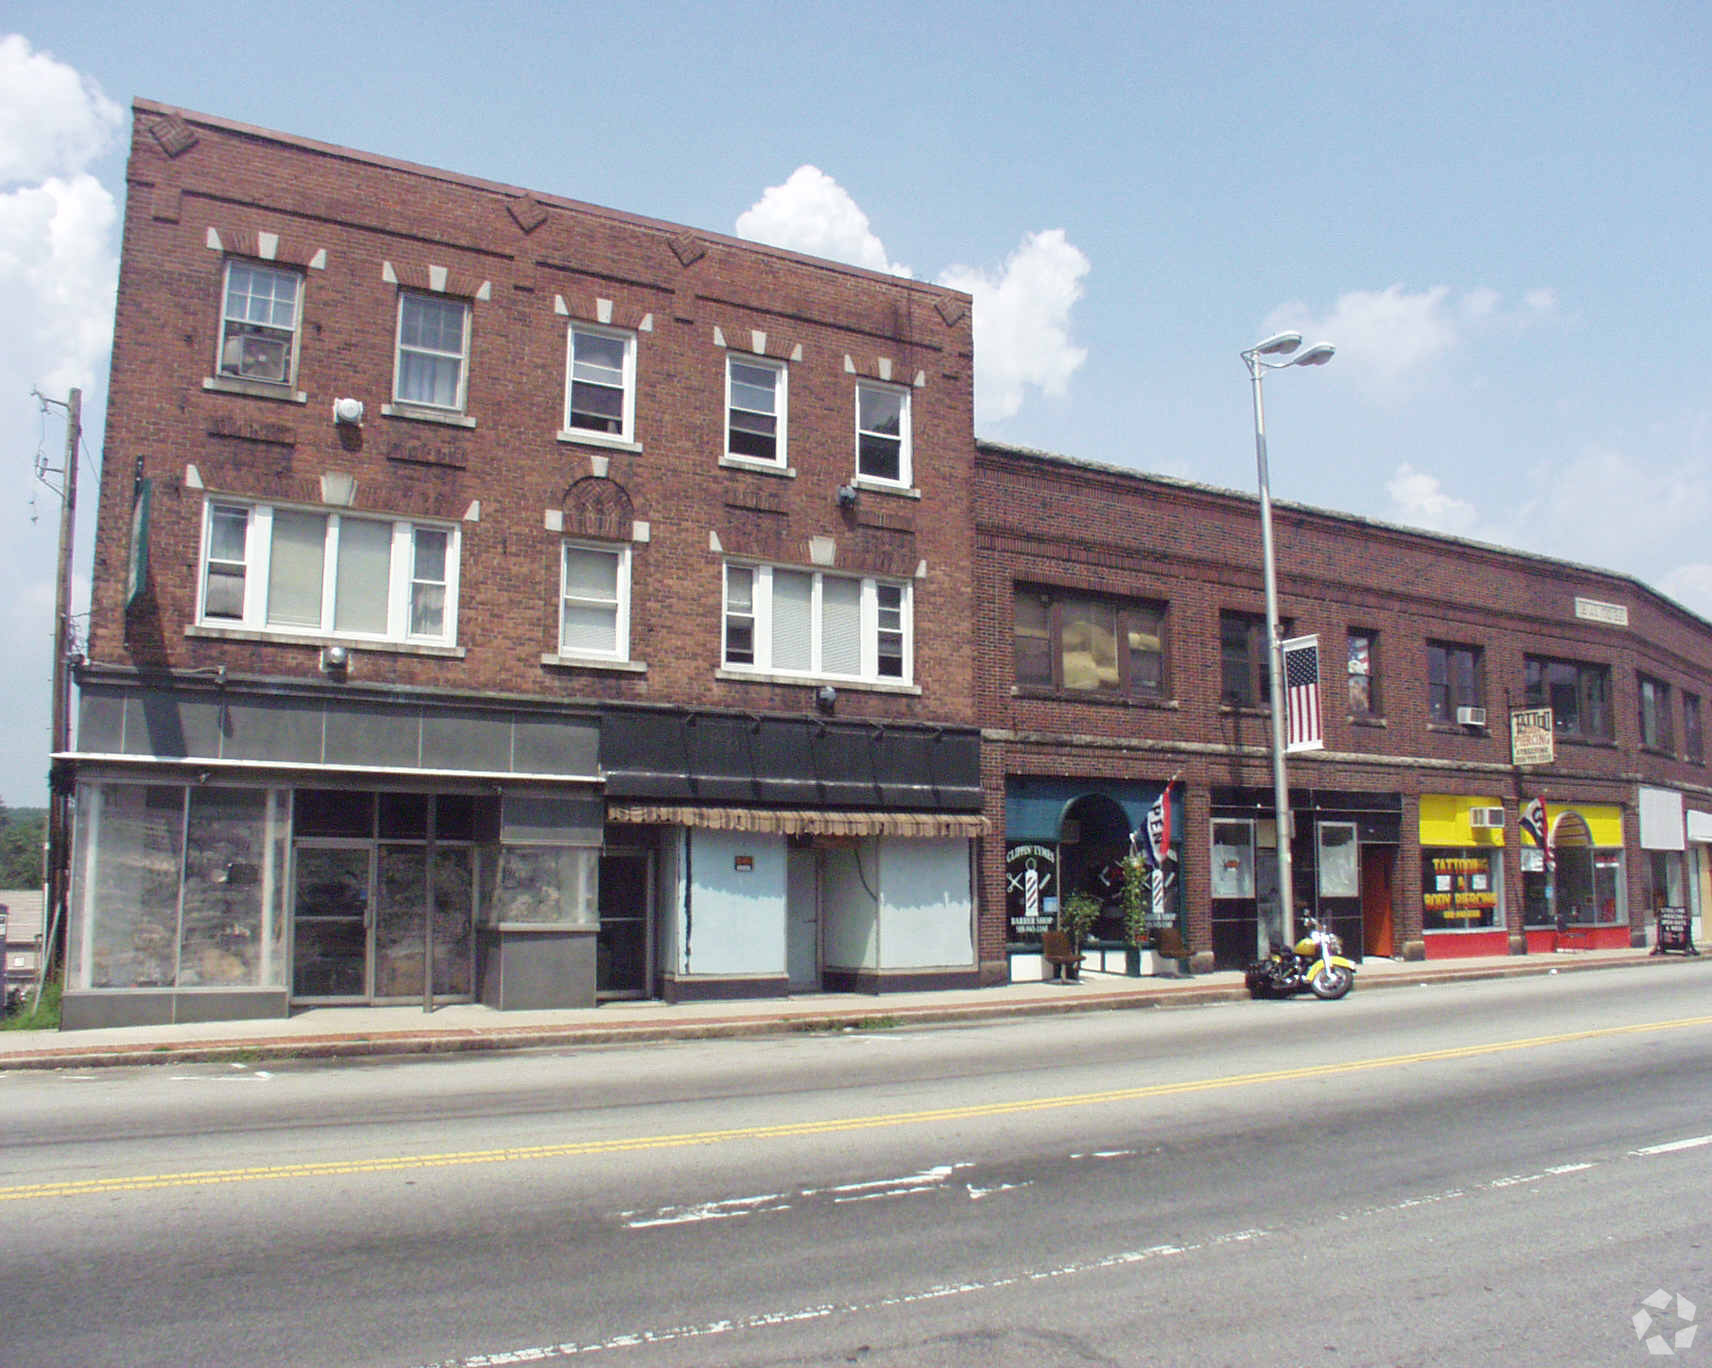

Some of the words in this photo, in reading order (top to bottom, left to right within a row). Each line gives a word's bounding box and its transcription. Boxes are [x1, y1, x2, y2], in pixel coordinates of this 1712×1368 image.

[1514, 711, 1550, 734] TATTOO
[1515, 734, 1550, 750] PIERCING
[1432, 857, 1489, 875] TATTOOING
[1424, 893, 1453, 911] BODY
[1454, 891, 1498, 909] PIERCING
[1011, 916, 1035, 925] BARBER
[1036, 916, 1053, 924] SHOP
